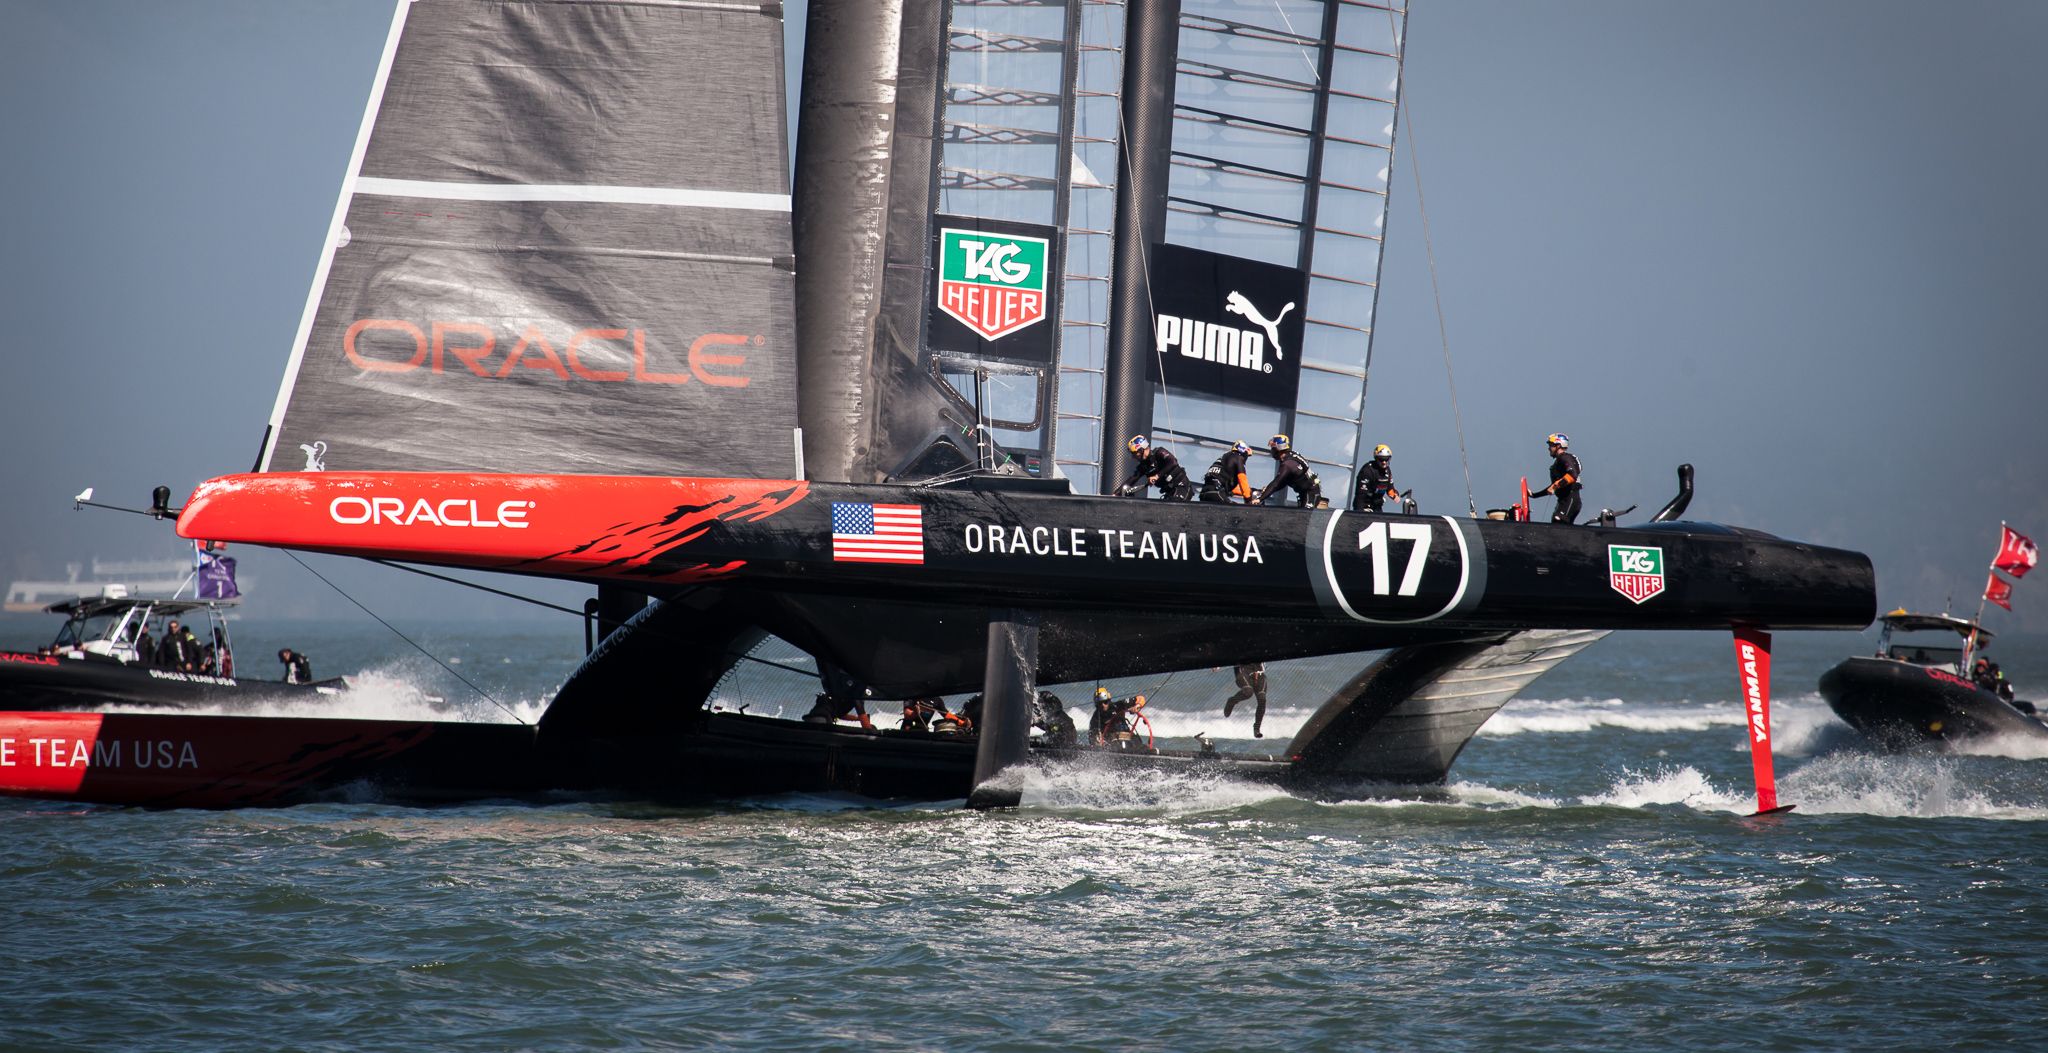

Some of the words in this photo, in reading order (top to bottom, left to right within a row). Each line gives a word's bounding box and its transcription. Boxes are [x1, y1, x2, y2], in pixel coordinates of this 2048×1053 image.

[958, 239, 1031, 284] TAG
[947, 285, 1038, 332] HEUER
[343, 318, 752, 388] ORACLE
[1157, 314, 1264, 372] PUMA
[329, 496, 530, 529] ORACLE
[965, 524, 1087, 556] ORACLE
[1098, 529, 1188, 560] TEAM
[1200, 534, 1264, 564] USA
[1358, 521, 1433, 597] 17
[1617, 550, 1655, 573] TAG
[1614, 575, 1661, 599] HEUER
[1741, 644, 1767, 743] YANMAR
[29, 738, 121, 768] TEAM
[134, 740, 199, 769] USA
